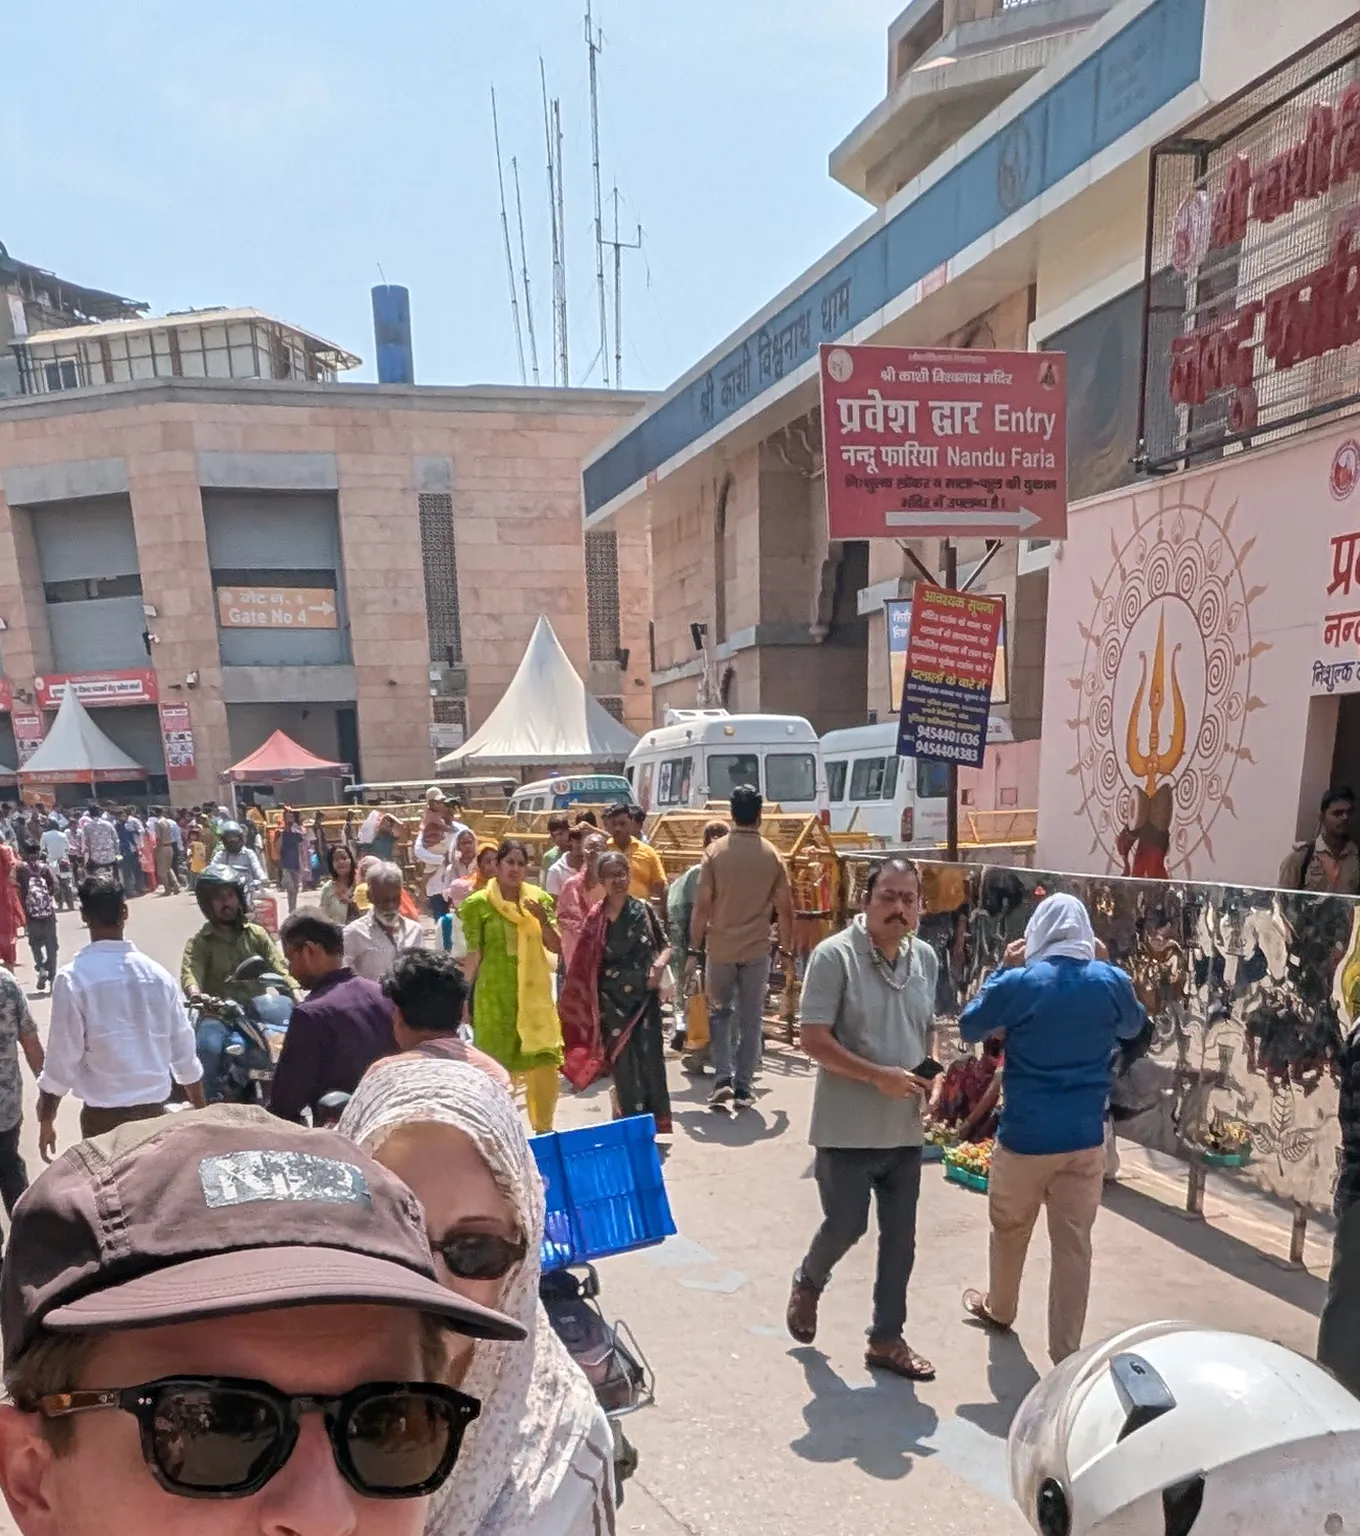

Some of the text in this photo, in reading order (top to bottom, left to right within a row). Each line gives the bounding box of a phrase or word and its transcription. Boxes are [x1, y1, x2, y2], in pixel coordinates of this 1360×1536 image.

[836, 389, 1056, 441] प्रवेश द्वार Entry
[840, 440, 1056, 475] नन्दू फारिया Nandu Faria
[229, 607, 307, 624] Gate No 4
